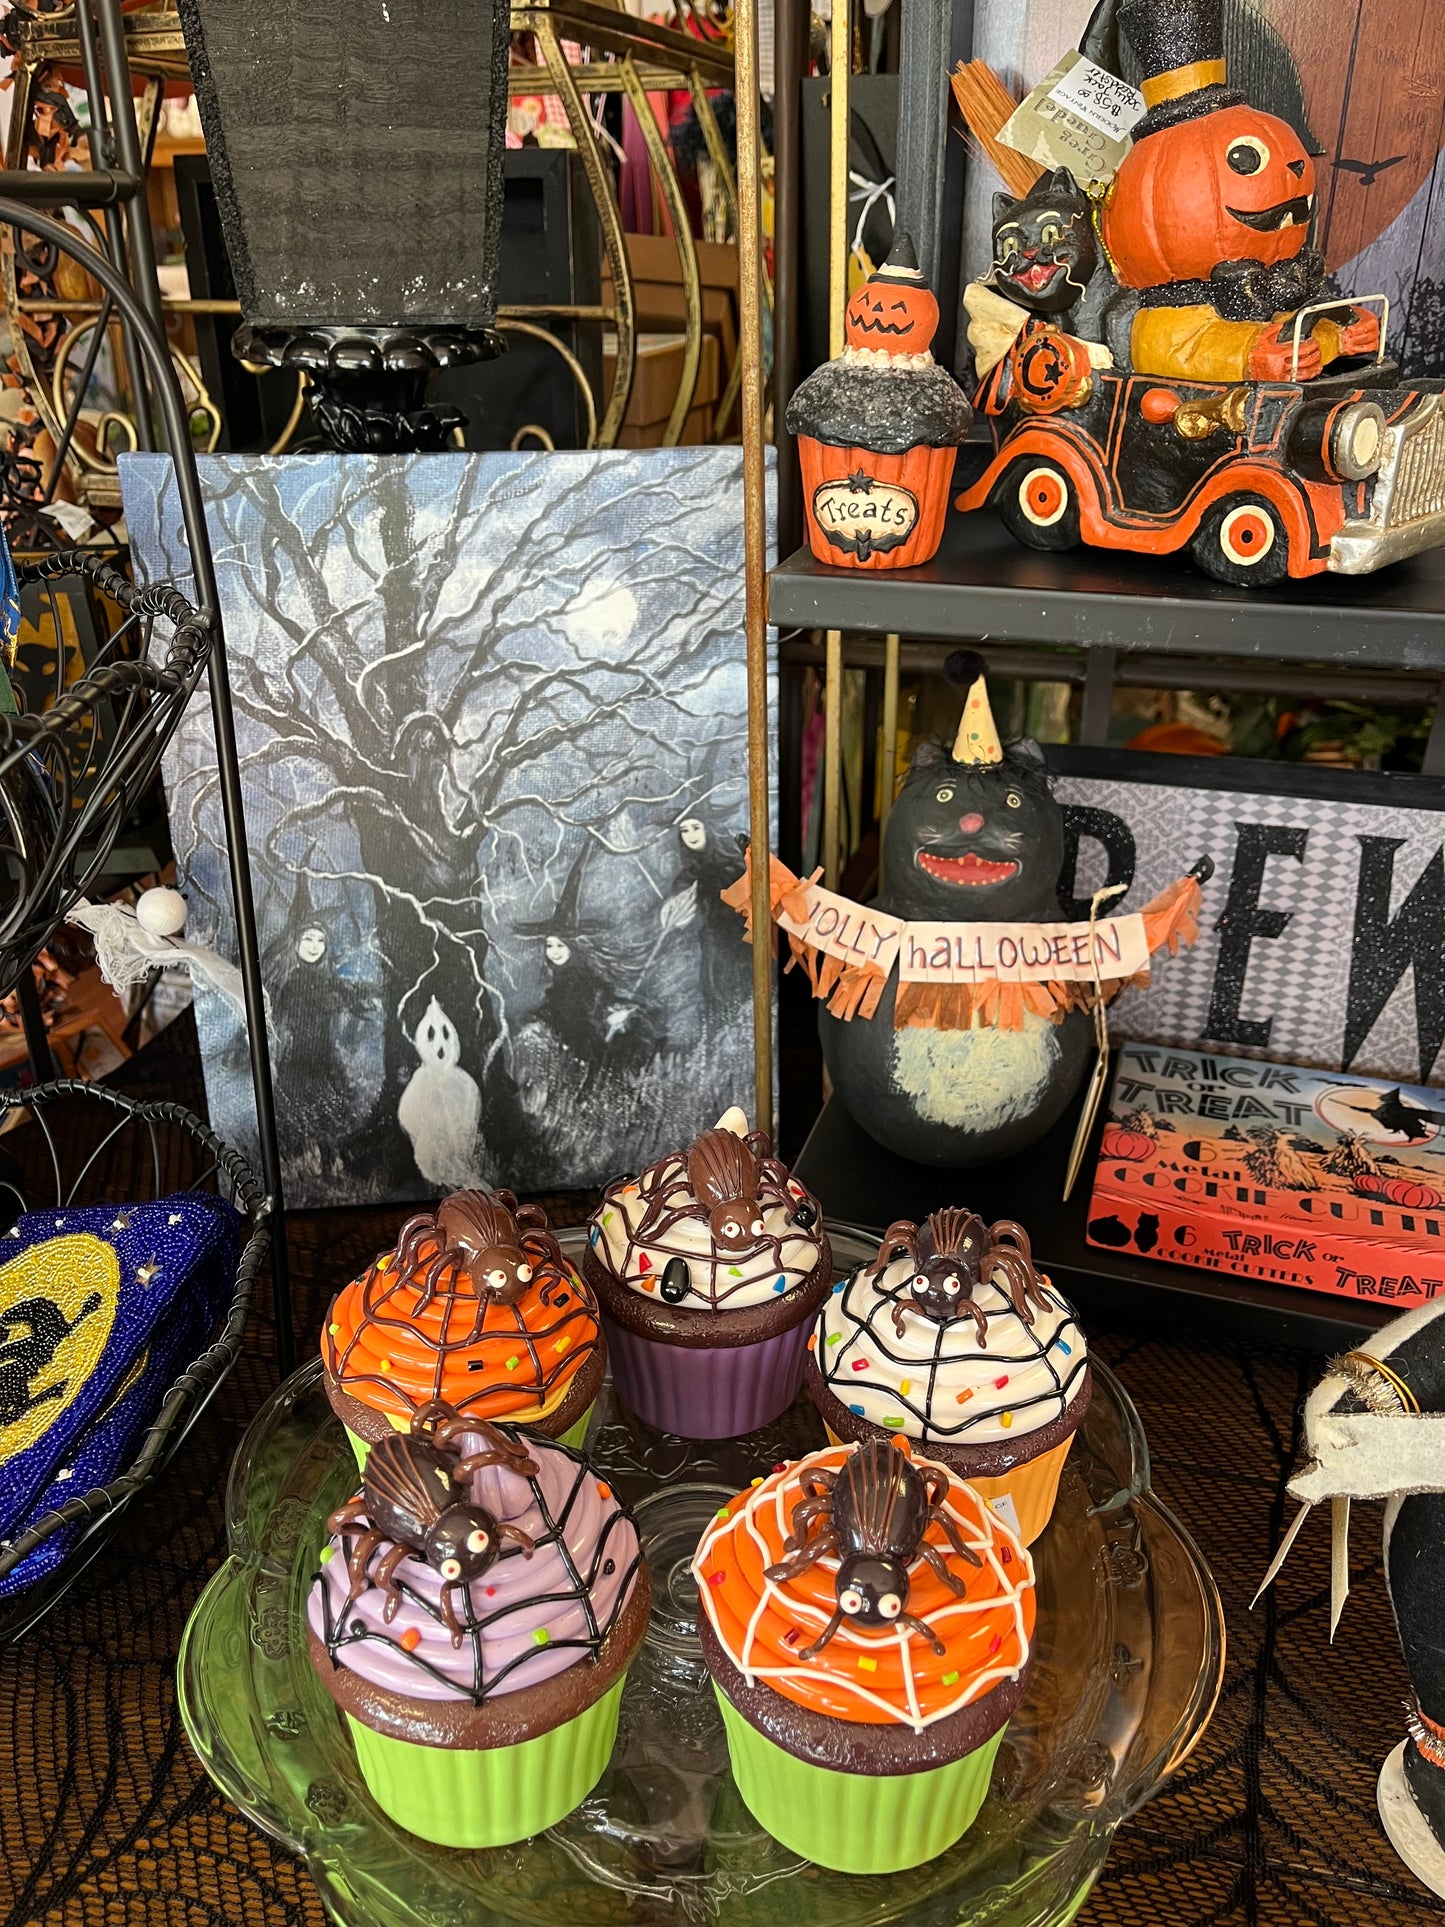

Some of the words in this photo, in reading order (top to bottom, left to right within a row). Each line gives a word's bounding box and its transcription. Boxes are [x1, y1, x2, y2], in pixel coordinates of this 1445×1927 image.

[1034, 98, 1106, 150] Guedel
[1059, 130, 1106, 171] Greg
[819, 497, 908, 526] Treats
[1124, 1051, 1302, 1094] TRICK
[1186, 1082, 1226, 1093] or
[1117, 1076, 1313, 1126] TREAT
[1183, 1140, 1217, 1163] 6
[1155, 1160, 1241, 1182] Metal
[1114, 1167, 1280, 1208] COOKIE
[1174, 1225, 1197, 1247] 6
[1222, 1230, 1317, 1262] TRICK
[1156, 1247, 1225, 1269] COOKIE
[1230, 1262, 1314, 1285] CUTTERS
[1203, 1247, 1245, 1261] Metal
[1322, 1252, 1345, 1263] or
[1335, 1266, 1444, 1299] TREAT
